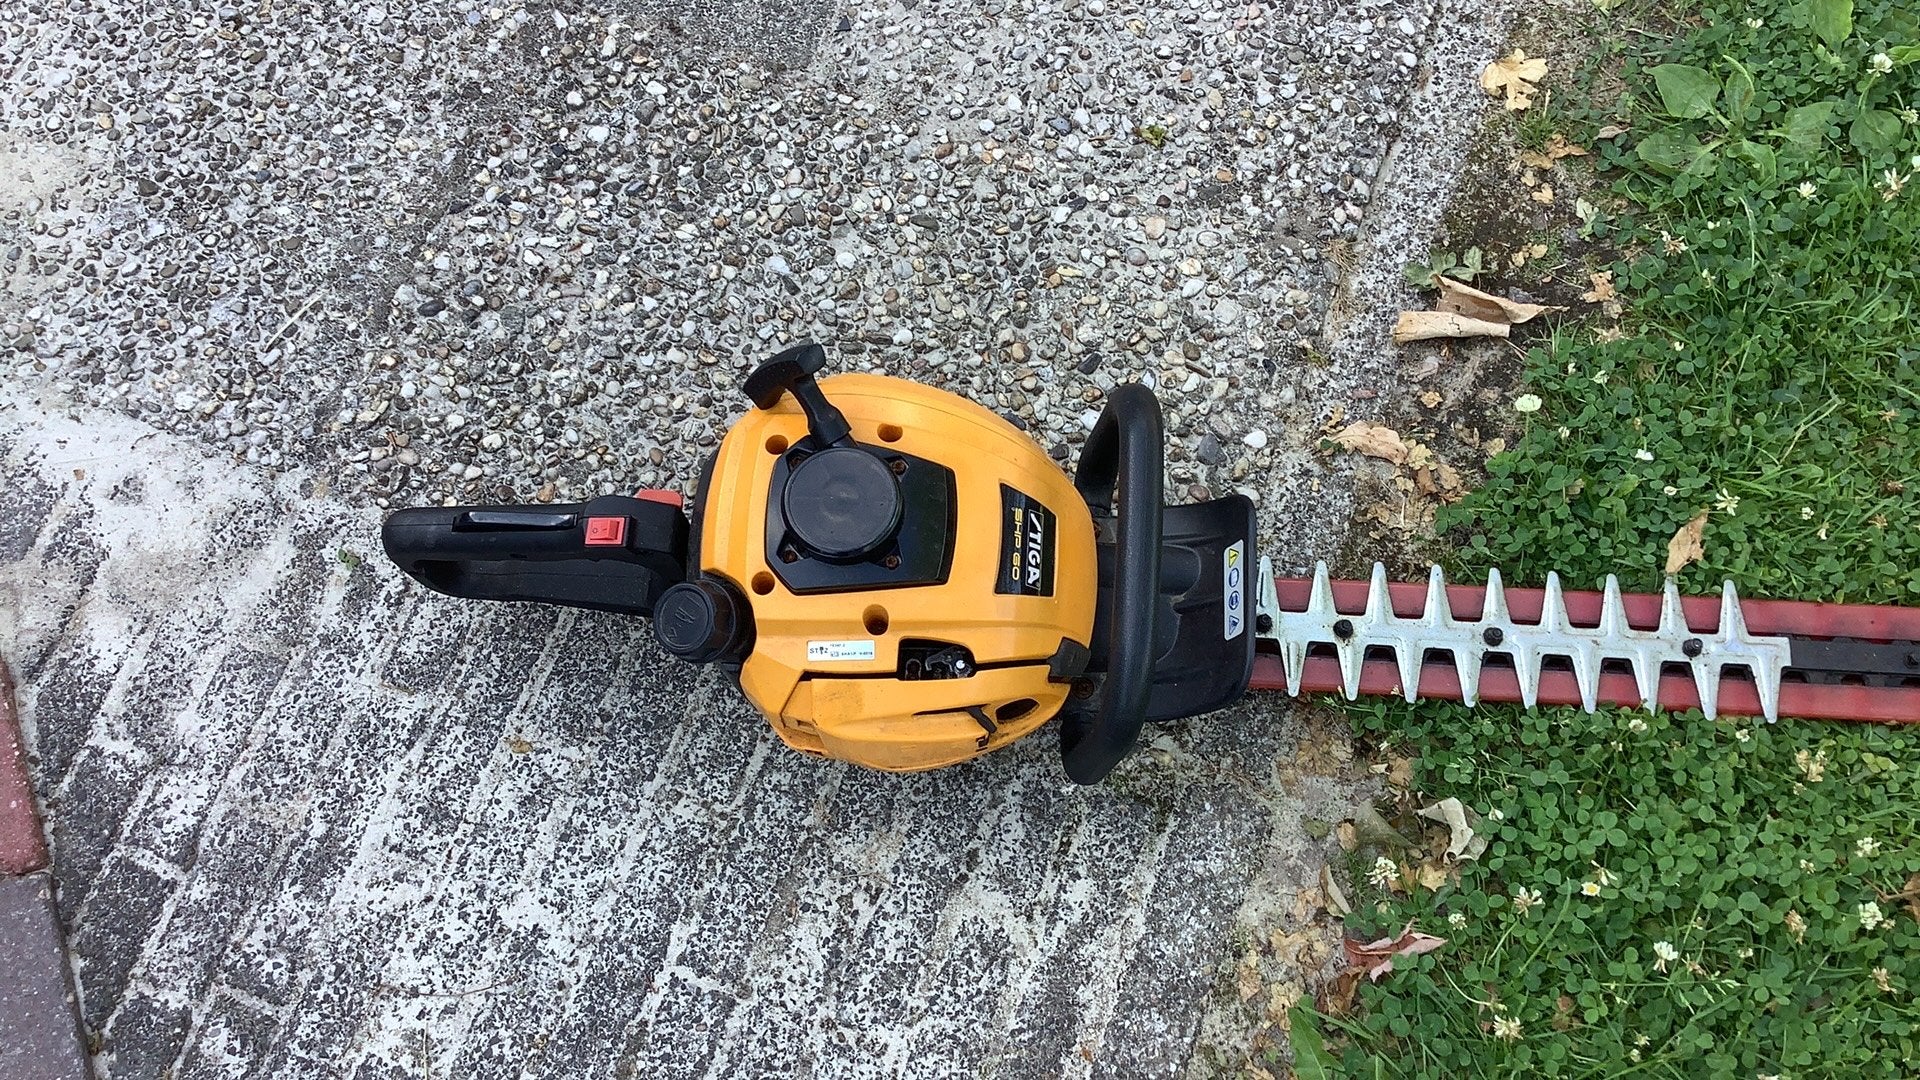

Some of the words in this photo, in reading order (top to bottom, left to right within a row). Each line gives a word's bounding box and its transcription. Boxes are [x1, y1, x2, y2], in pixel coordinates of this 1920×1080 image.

[1014, 507, 1023, 549] SHP
[1027, 512, 1042, 585] STIGA
[1012, 552, 1021, 581] 60
